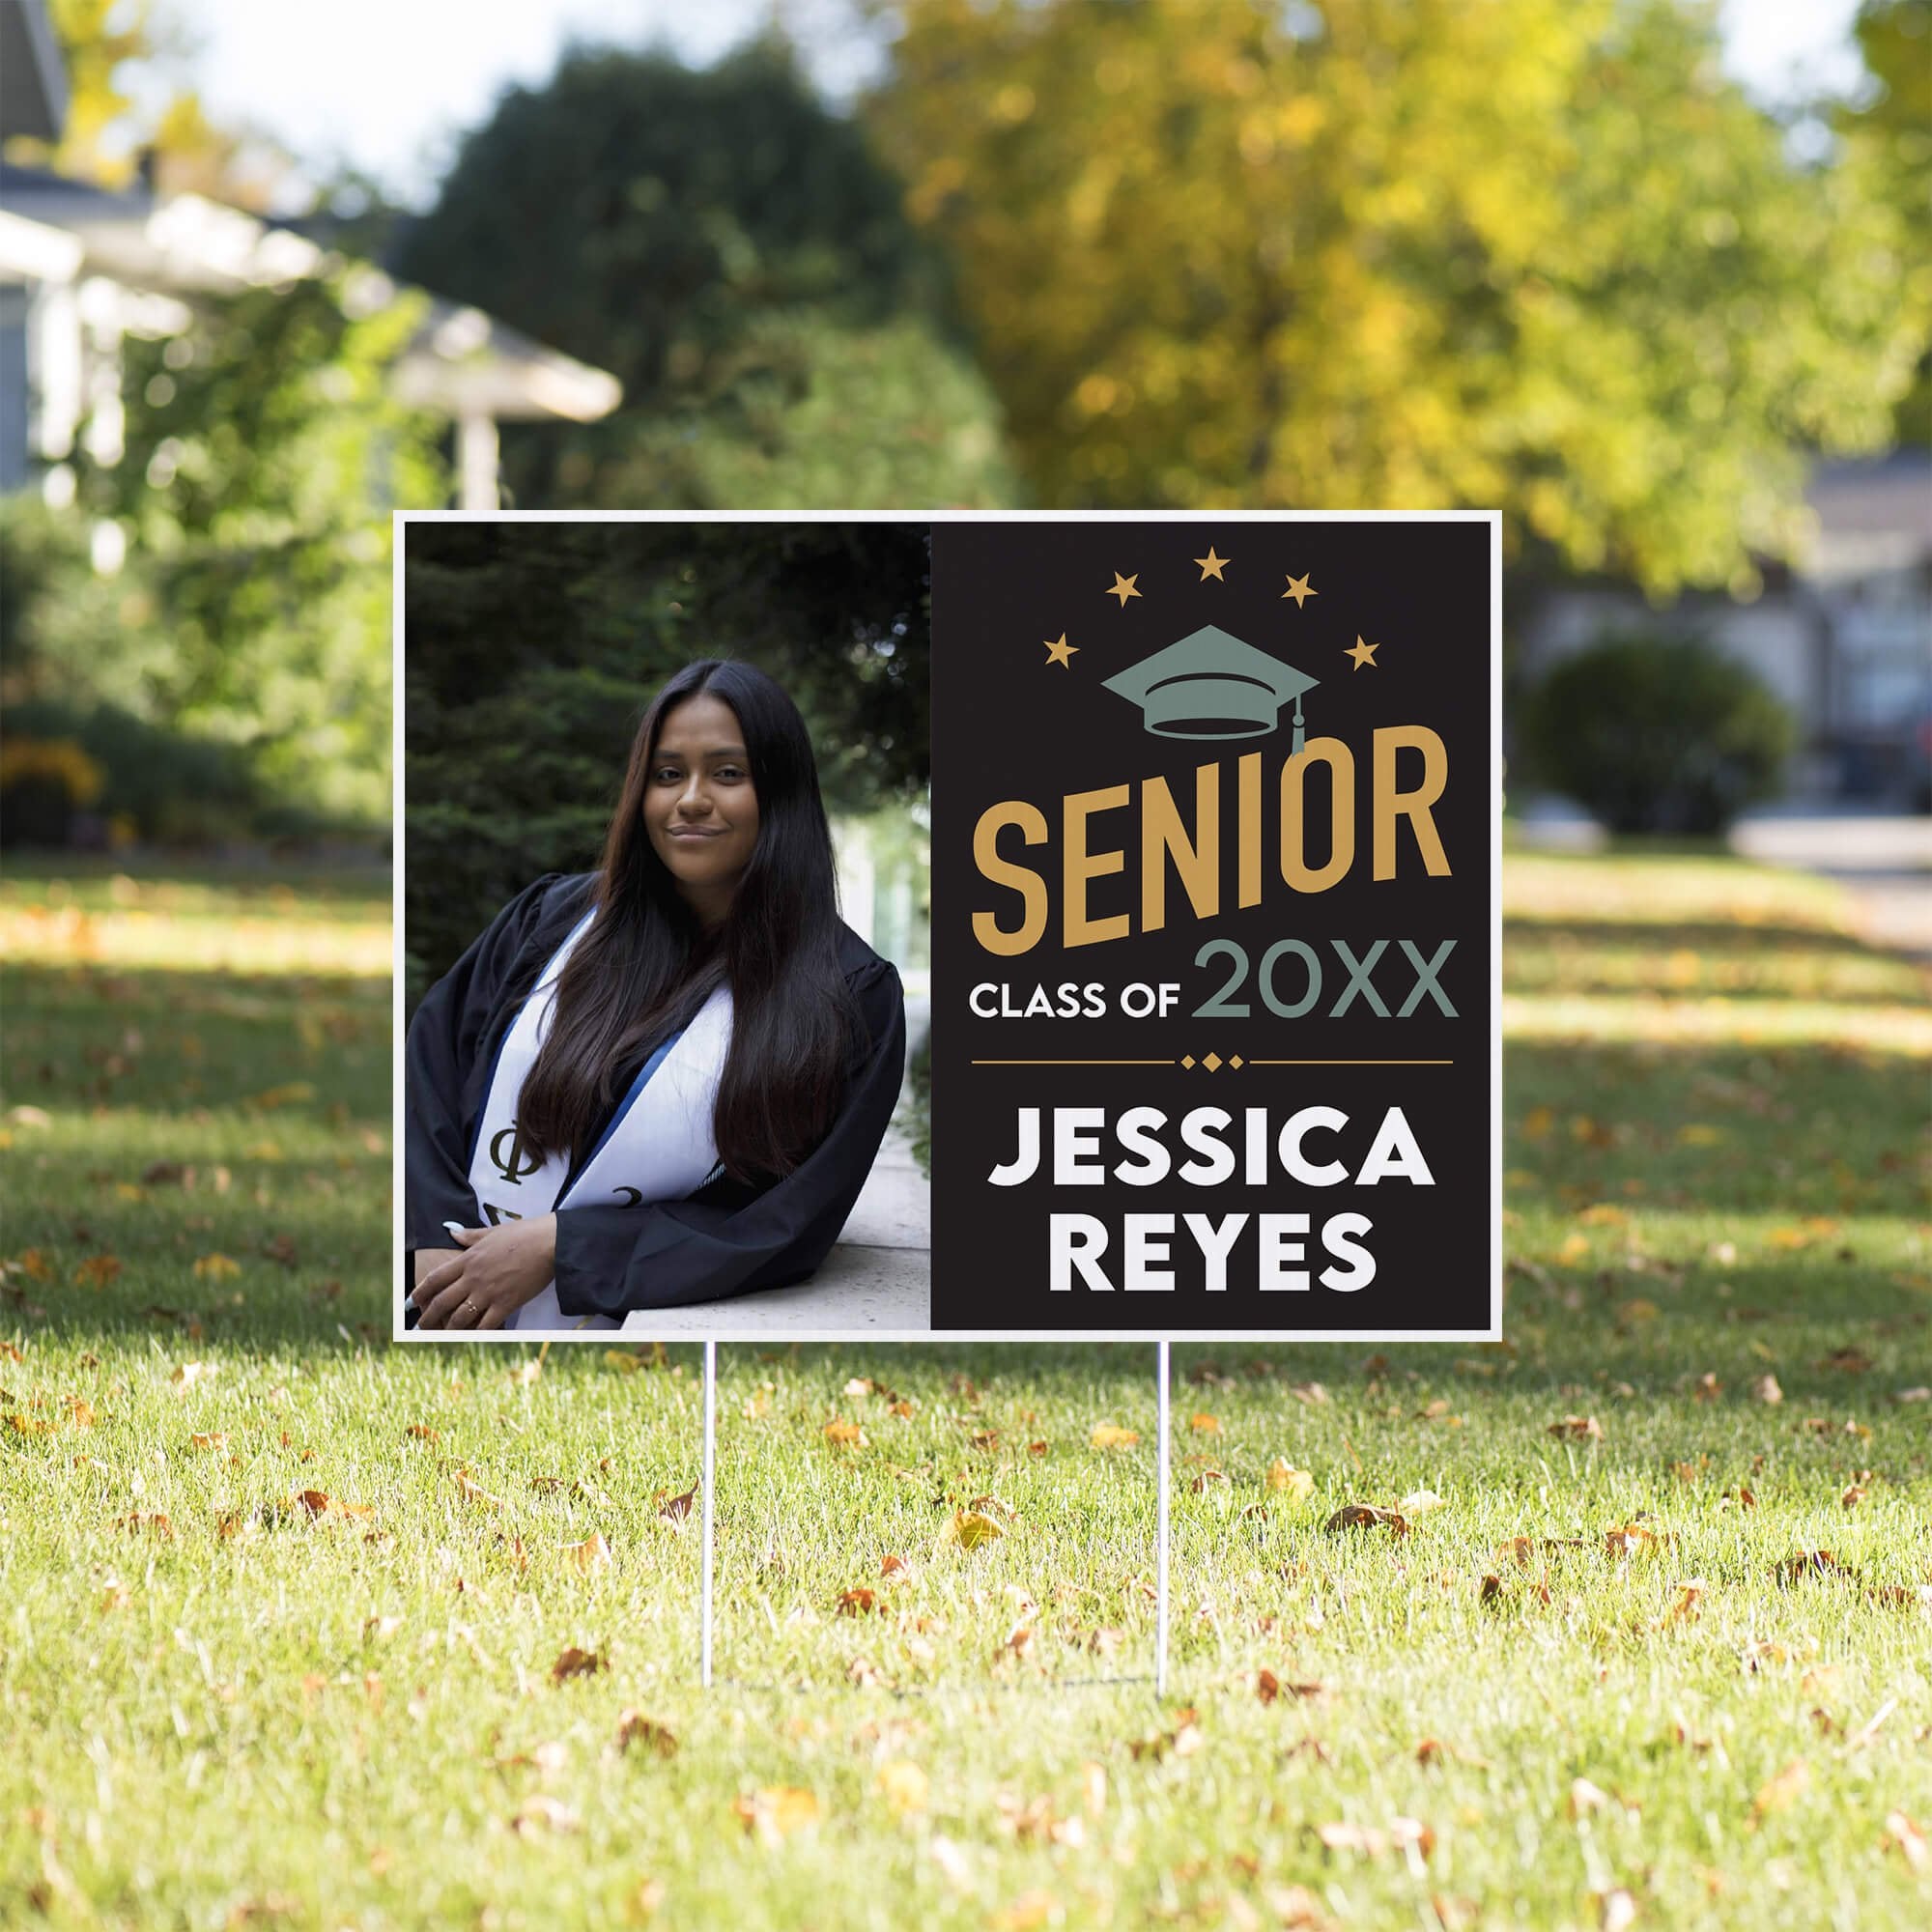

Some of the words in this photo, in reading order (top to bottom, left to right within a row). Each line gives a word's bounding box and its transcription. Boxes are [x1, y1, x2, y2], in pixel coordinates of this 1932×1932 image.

[971, 724, 1453, 957] SENIOR
[968, 981, 1107, 1019] CLASS
[1120, 981, 1181, 1019] OF
[1191, 938, 1460, 1019] 20XX
[986, 1106, 1436, 1187] JESSICA
[1049, 1211, 1377, 1293] REYES
